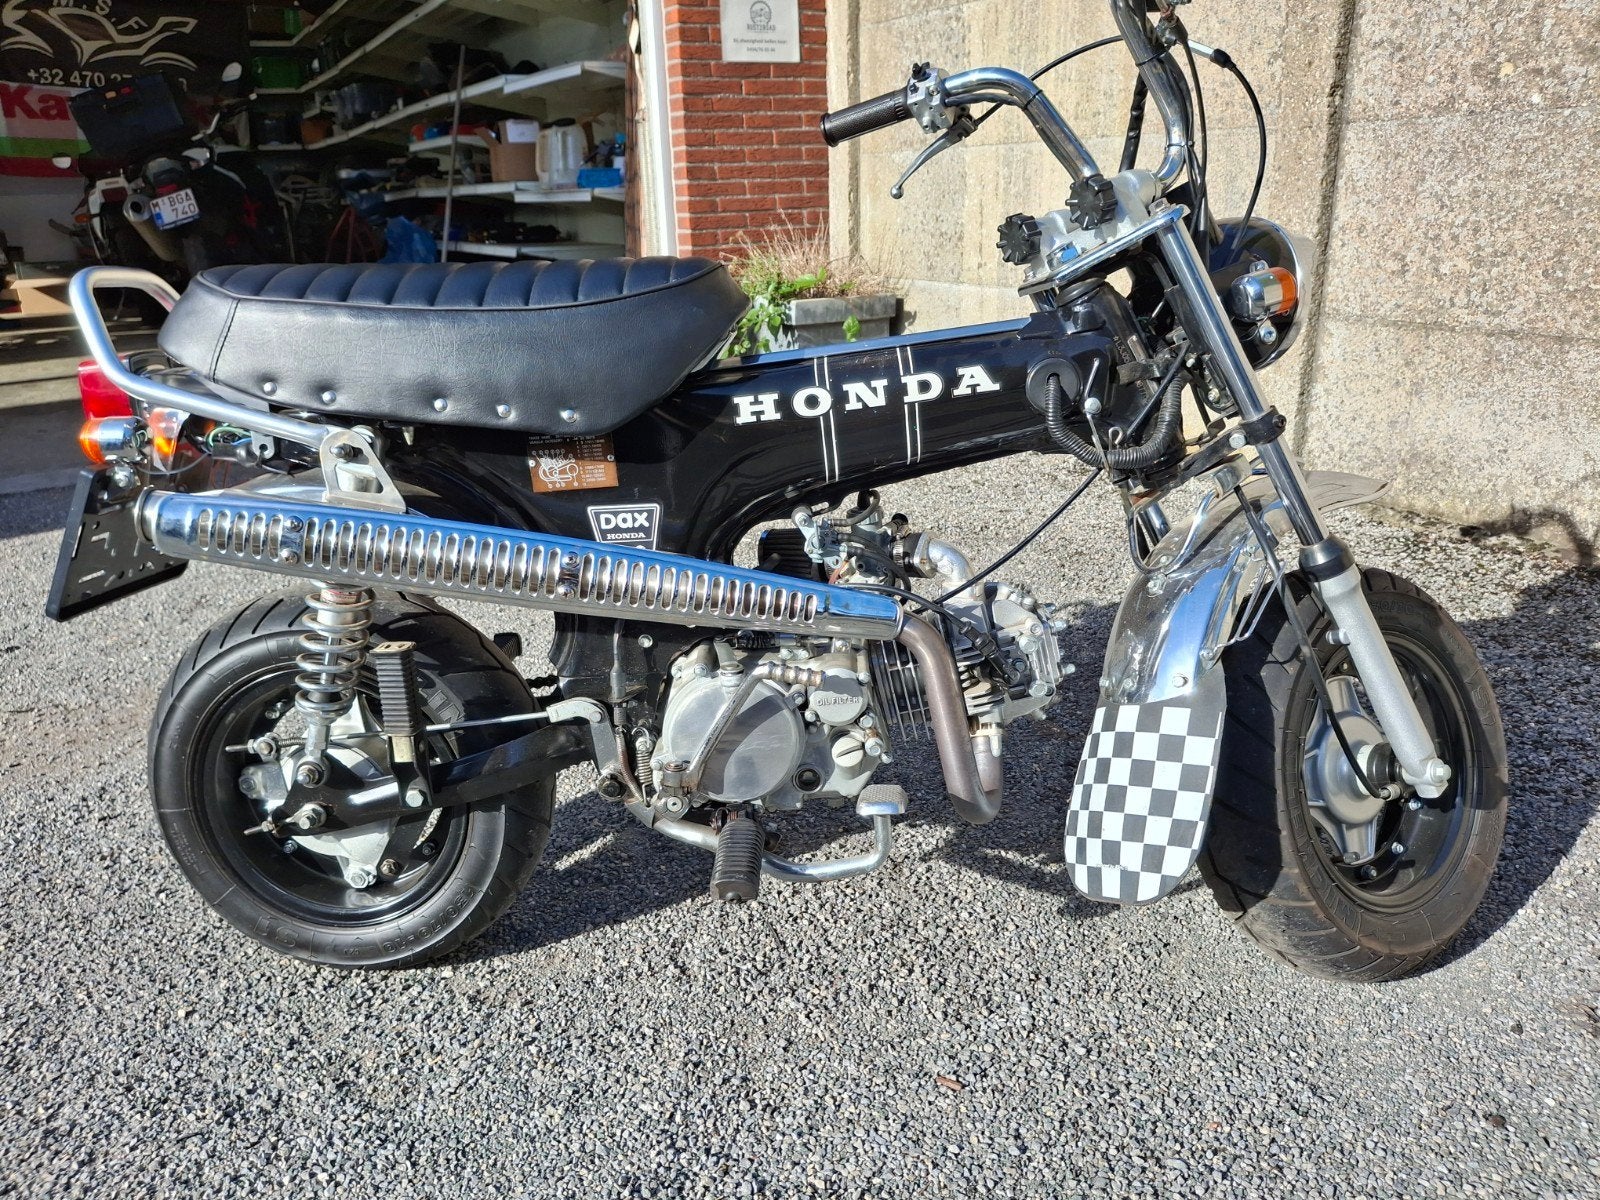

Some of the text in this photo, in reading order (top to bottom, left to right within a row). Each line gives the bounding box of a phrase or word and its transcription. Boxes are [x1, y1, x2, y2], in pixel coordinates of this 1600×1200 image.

[27, 68, 65, 85] +32
[69, 71, 106, 88] 470
[0, 83, 71, 121] Ka
[168, 191, 192, 207] BGA
[172, 203, 196, 219] 740
[733, 364, 1001, 425] HONDA
[606, 532, 646, 540] HONDA
[816, 696, 860, 706] OIL FILTER
